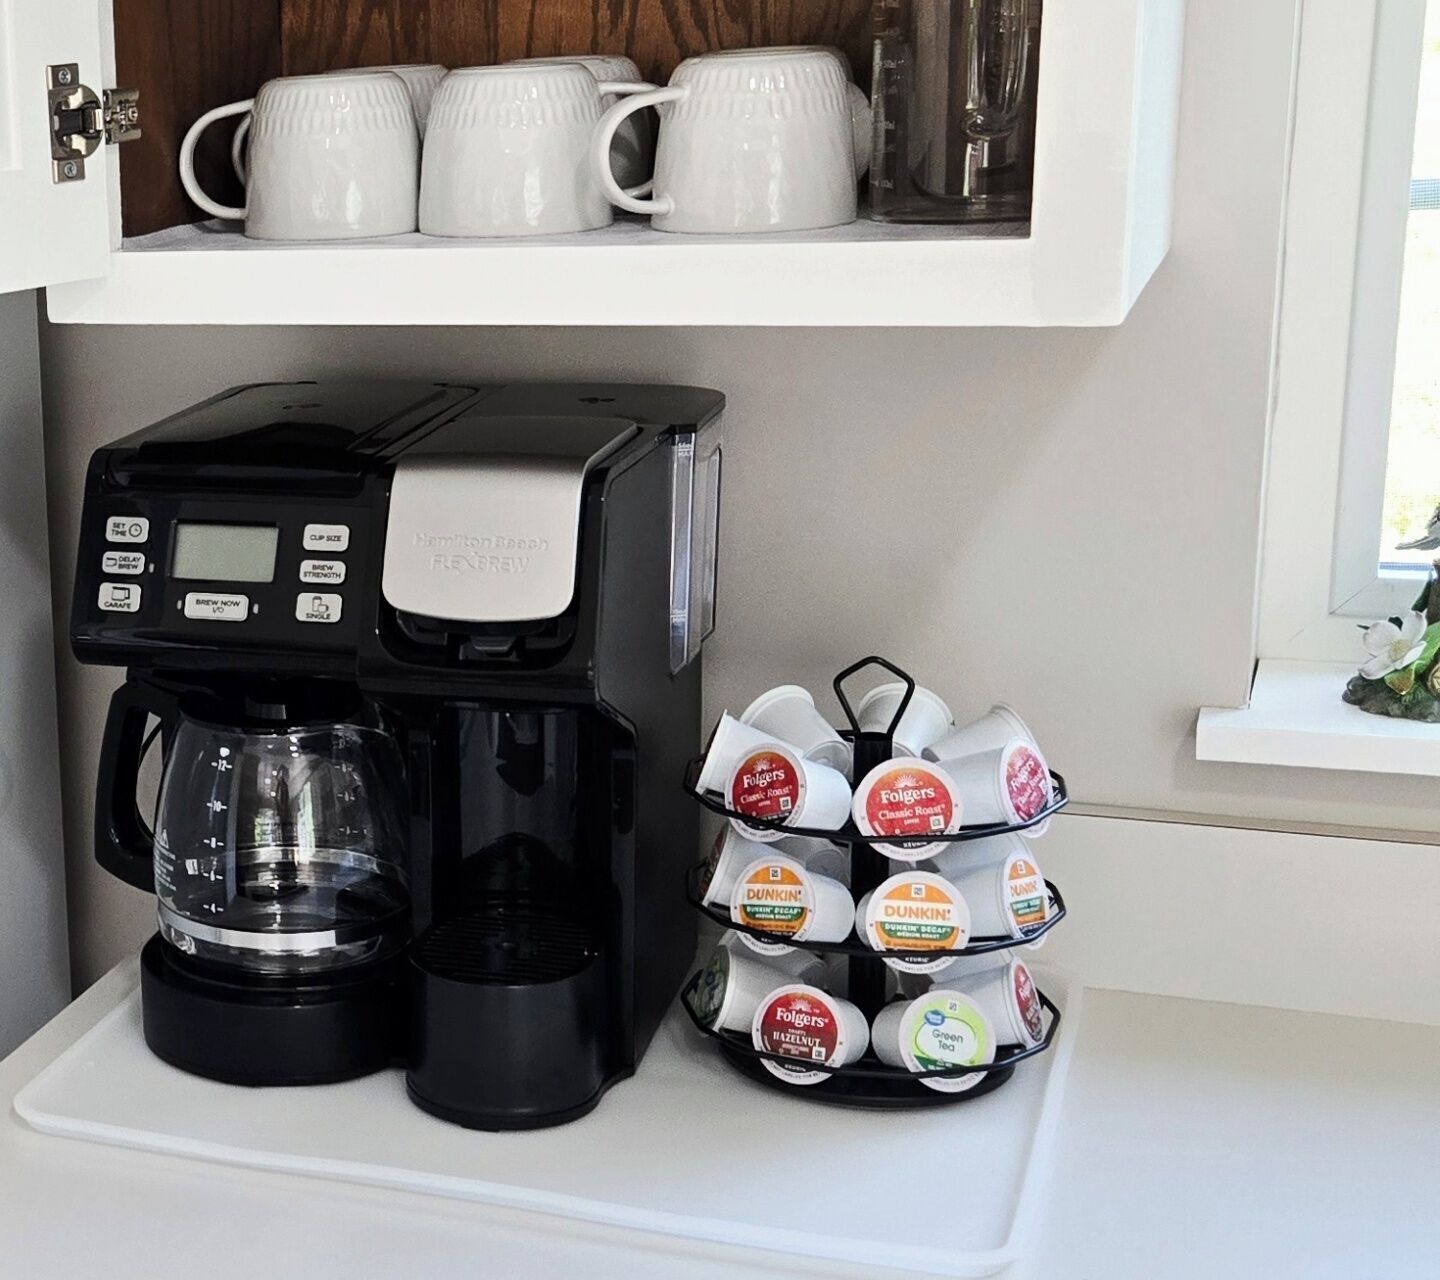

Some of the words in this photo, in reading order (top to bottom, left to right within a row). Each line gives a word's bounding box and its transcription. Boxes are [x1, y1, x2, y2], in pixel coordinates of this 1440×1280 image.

[112, 522, 126, 530] SET
[111, 529, 128, 537] TIME
[325, 534, 342, 542] SIZE
[118, 555, 141, 563] DELAY
[118, 562, 139, 570] BREW
[303, 571, 342, 579] STRENGTH
[104, 602, 132, 610] CARAFE
[195, 598, 219, 607] BREW
[220, 600, 241, 608] NOW
[305, 612, 332, 620] SINGLE
[743, 769, 785, 788] Folgers
[880, 787, 936, 804] Folgers
[879, 808, 914, 820] Classic
[915, 805, 942, 816] Roast
[747, 888, 801, 902] DUNKIN'
[884, 905, 951, 921] DUNKIN'
[776, 1007, 825, 1028] Folgers
[773, 1031, 821, 1048] HAZELNUT
[932, 1029, 964, 1045] Green
[938, 1040, 955, 1052] Tea
